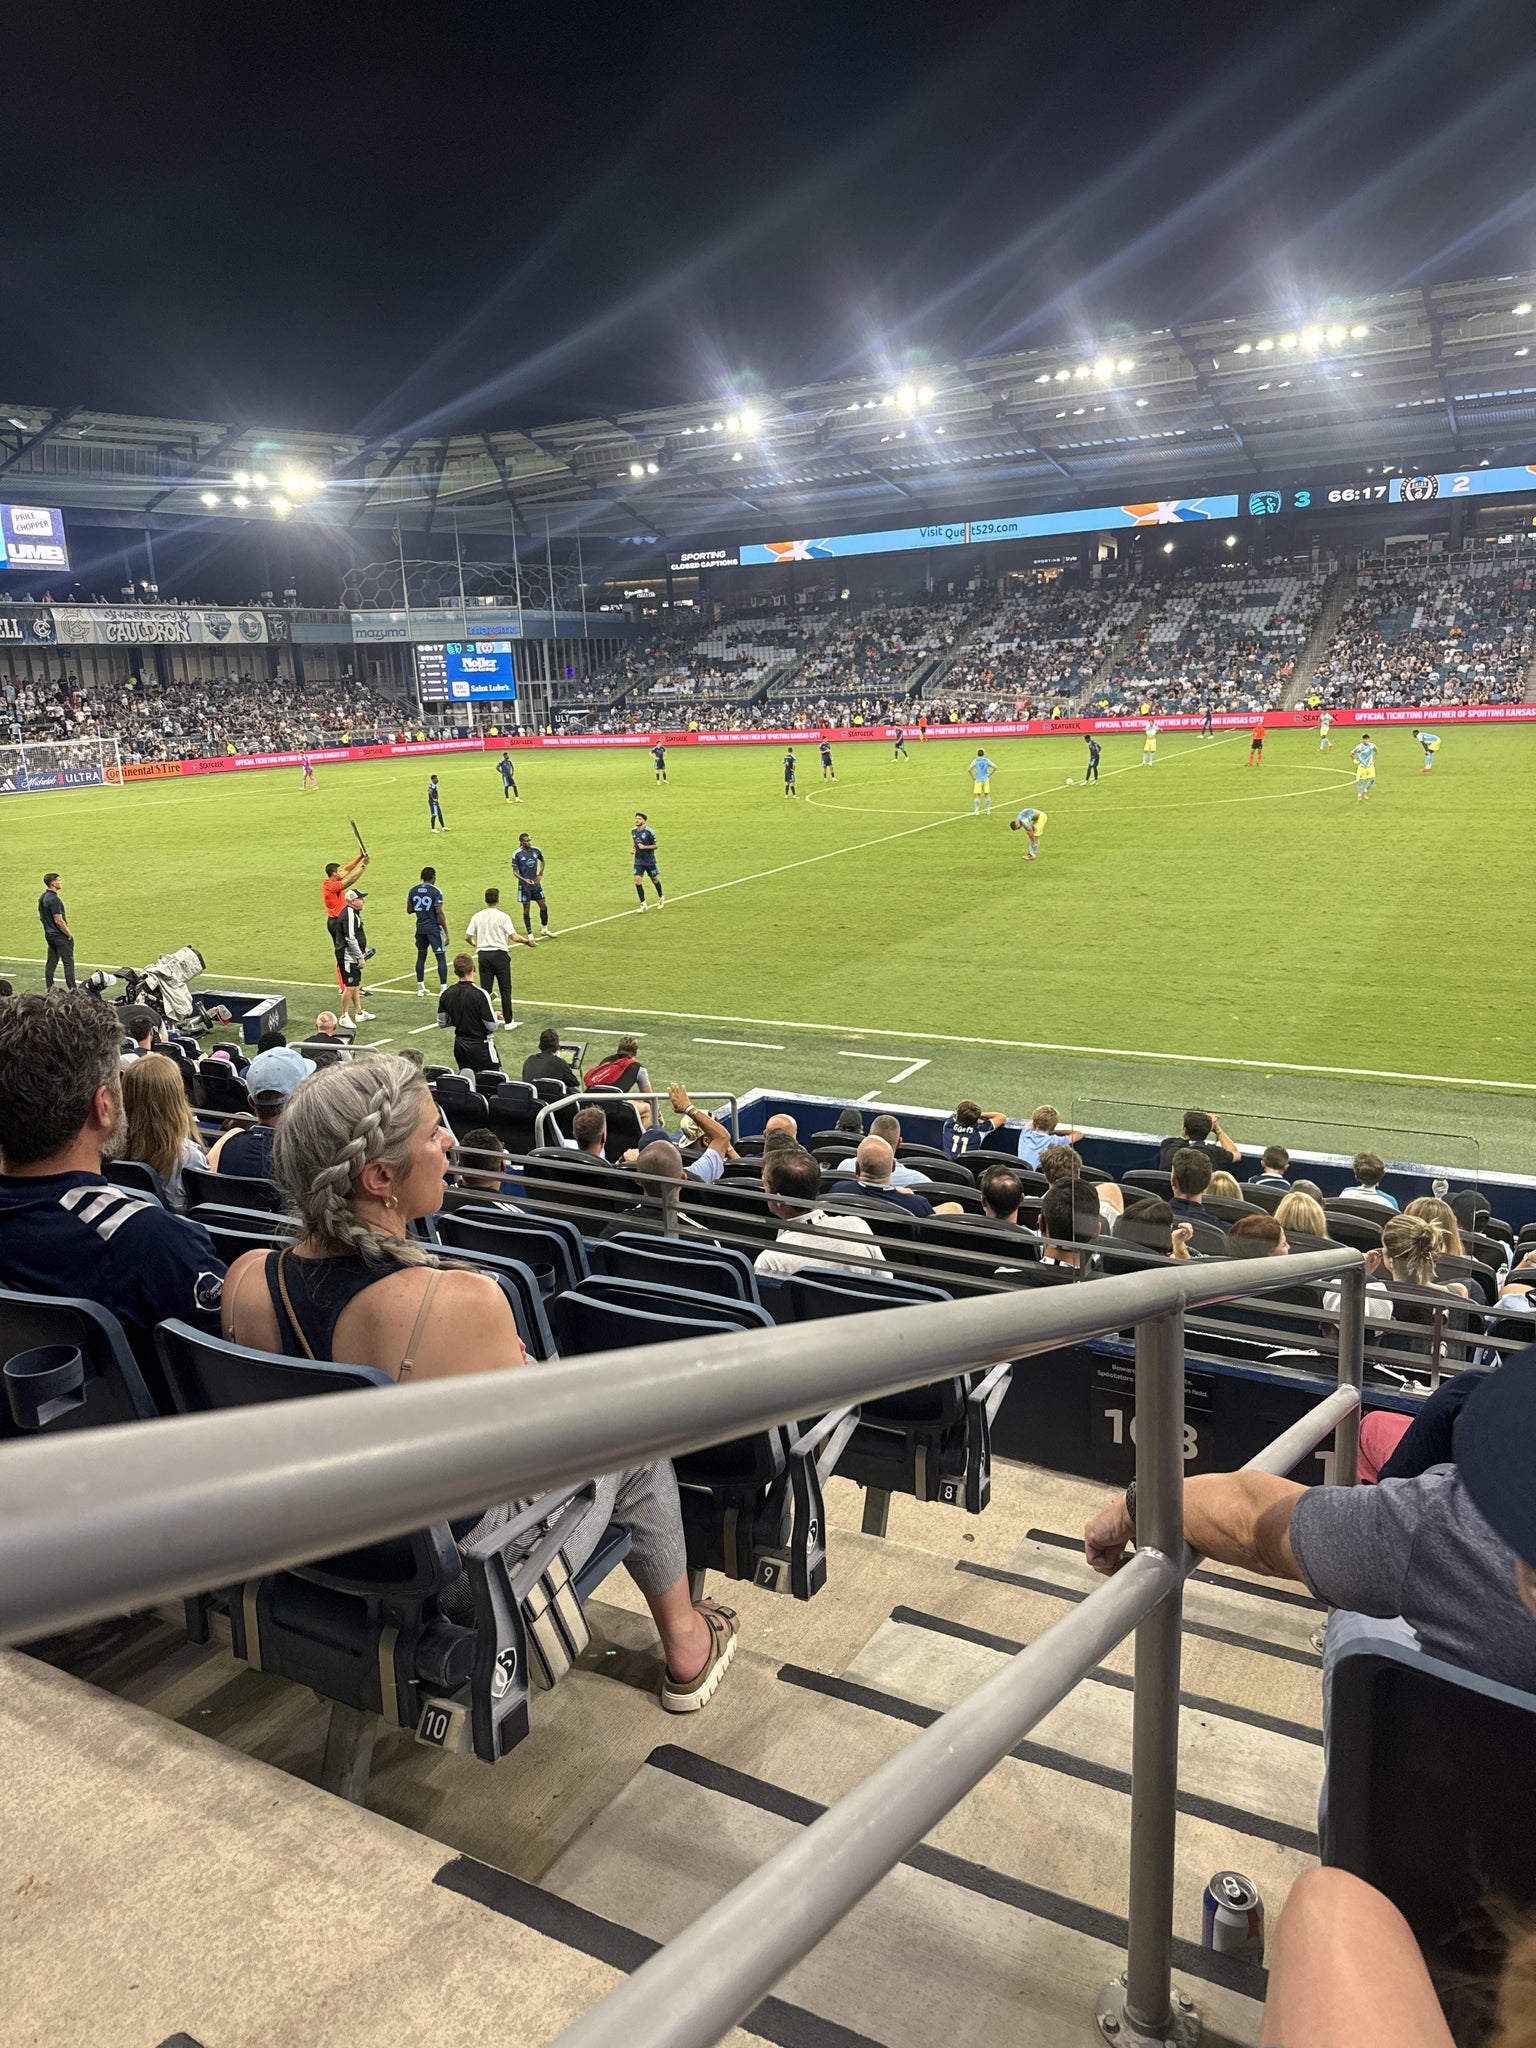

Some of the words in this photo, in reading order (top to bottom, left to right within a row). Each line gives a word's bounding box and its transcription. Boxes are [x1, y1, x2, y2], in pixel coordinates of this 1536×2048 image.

[1452, 475, 1471, 493] 2
[1293, 491, 1312, 508] 3
[1328, 486, 1387, 503] 66:17
[15, 512, 36, 521] PRICE
[16, 520, 50, 532] CHOPPER
[920, 527, 943, 538] Visit
[945, 522, 1018, 540] Quet529.com
[7, 543, 64, 560] UMB
[681, 550, 726, 561] SPORTING
[671, 562, 700, 570] CLOSED
[700, 559, 739, 568] CAPTIONS
[105, 621, 192, 643] CAULDRON
[1355, 712, 1384, 720] OFFICIAL
[1385, 711, 1423, 719] TICKETING
[1424, 710, 1456, 718] PARTNER
[1467, 709, 1504, 717] SPORTING
[1505, 707, 1536, 716] KANSAS
[1051, 722, 1080, 730] SEATGEEK
[1095, 721, 1120, 729] OFFICIAL
[1223, 716, 1248, 724] KANSAS
[161, 763, 180, 774] Tire
[65, 771, 100, 783] ULTRA
[412, 895, 433, 912] 29
[951, 1135, 969, 1153] 11
[1097, 1369, 1134, 1382] Spectators
[1104, 1408, 1199, 1460] 18
[945, 1485, 953, 1500] 8
[764, 1566, 774, 1583] 9
[426, 1711, 447, 1739] 10
